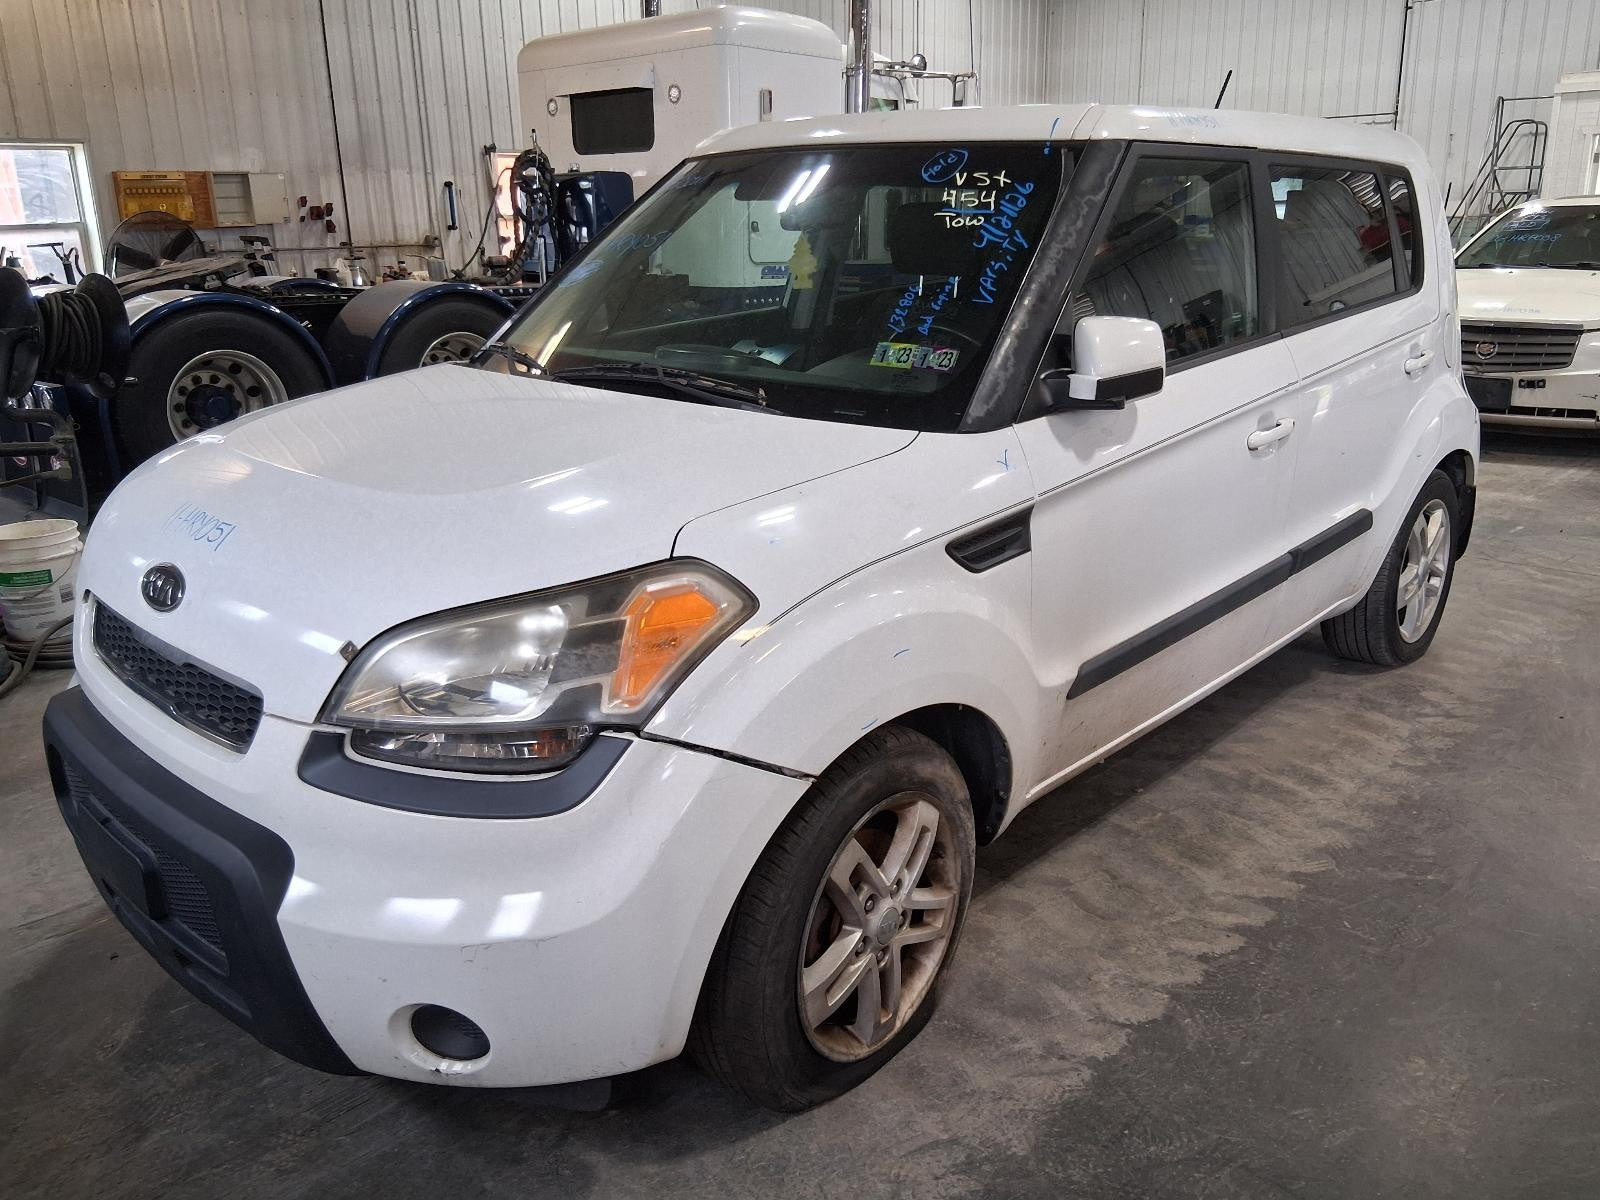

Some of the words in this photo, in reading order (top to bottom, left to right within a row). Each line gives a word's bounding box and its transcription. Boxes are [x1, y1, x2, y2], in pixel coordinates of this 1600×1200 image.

[880, 348, 887, 363] 1
[896, 347, 913, 363] 23
[921, 352, 929, 366] 1
[938, 351, 954, 368] 23
